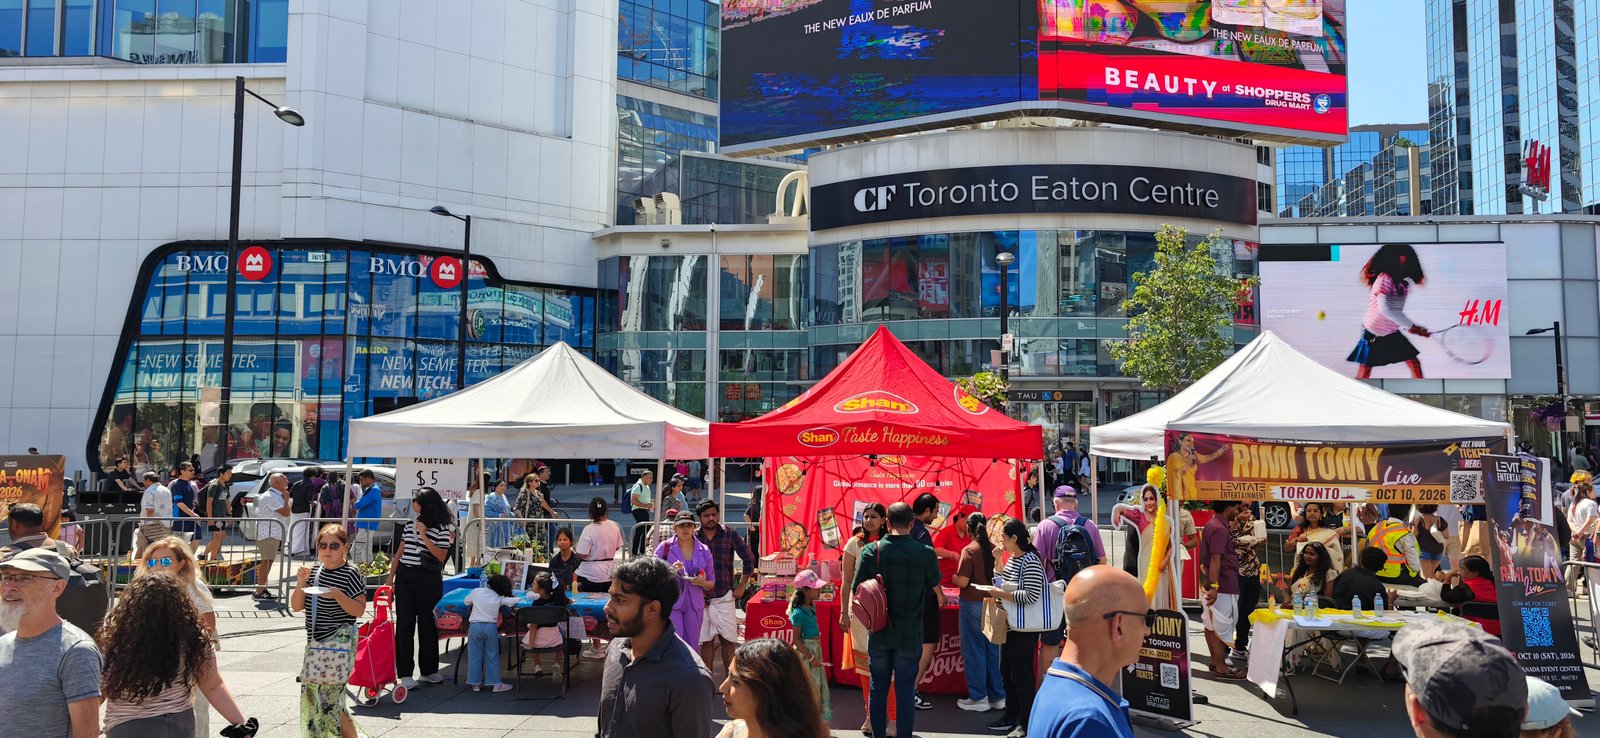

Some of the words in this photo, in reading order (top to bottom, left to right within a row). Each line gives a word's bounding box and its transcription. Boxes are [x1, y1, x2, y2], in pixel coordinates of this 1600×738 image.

[803, 22, 821, 35] THE
[823, 16, 847, 31] NEW
[849, 13, 875, 26] EAUX
[877, 10, 890, 20] DE
[892, 1, 933, 17] PARFUM
[1212, 28, 1228, 39] THE
[1230, 31, 1252, 42] NEW
[1254, 35, 1276, 46] EAUX
[1278, 39, 1289, 48] DE
[1291, 40, 1324, 53] PARFUM
[1105, 67, 1217, 98] BEAUTY
[1235, 84, 1311, 103] SHOPPERS
[1265, 98, 1287, 108] DRUG
[1288, 101, 1311, 110] MART
[1526, 140, 1551, 193] H&M
[853, 184, 897, 212] CF
[903, 178, 1019, 207] Toronto
[1031, 175, 1118, 201] Eaton
[1129, 177, 1219, 208] Centre
[177, 255, 229, 271] BMO
[369, 257, 425, 277] BMO
[1459, 299, 1502, 327] H&M
[143, 354, 180, 368] NEW
[185, 353, 260, 368] SEMETER.
[382, 356, 413, 371] NEW
[419, 357, 492, 373] SEMETER.
[143, 373, 178, 387] NEW
[184, 373, 221, 387] TECH.
[380, 375, 413, 389] NEW
[417, 375, 454, 390] TECH.
[843, 397, 907, 411] Shan
[802, 431, 834, 443] Shan
[841, 426, 879, 443] Taste
[882, 426, 949, 448] Happiness
[413, 457, 454, 465] PAINTING
[1232, 443, 1298, 480] RIMI
[1304, 447, 1384, 480] TOMY
[1495, 461, 1521, 473] LEVIT
[15, 467, 52, 495] ONAM
[416, 469, 426, 487] $
[431, 470, 439, 485] 5
[1382, 465, 1422, 486] Live
[0, 486, 23, 499] 2026
[852, 481, 877, 489] presence
[1220, 482, 1266, 491] LEVITATE
[1220, 491, 1266, 500] ENTERTAINMENT
[1280, 486, 1340, 500] TORONTO
[1376, 489, 1398, 500] OCT
[1401, 489, 1416, 501] 10,
[1419, 489, 1446, 500] 2026
[1500, 565, 1525, 582] RIMI
[1527, 567, 1559, 583] TOMY
[1524, 575, 1544, 597] Live
[763, 619, 784, 627] Shan
[1148, 638, 1181, 649] TORONTO
[1518, 652, 1531, 660] OCT
[1533, 652, 1539, 660] 10
[1561, 652, 1575, 660] 2026
[1136, 670, 1154, 681] TICKETS
[1146, 695, 1170, 704] LEVITATE
